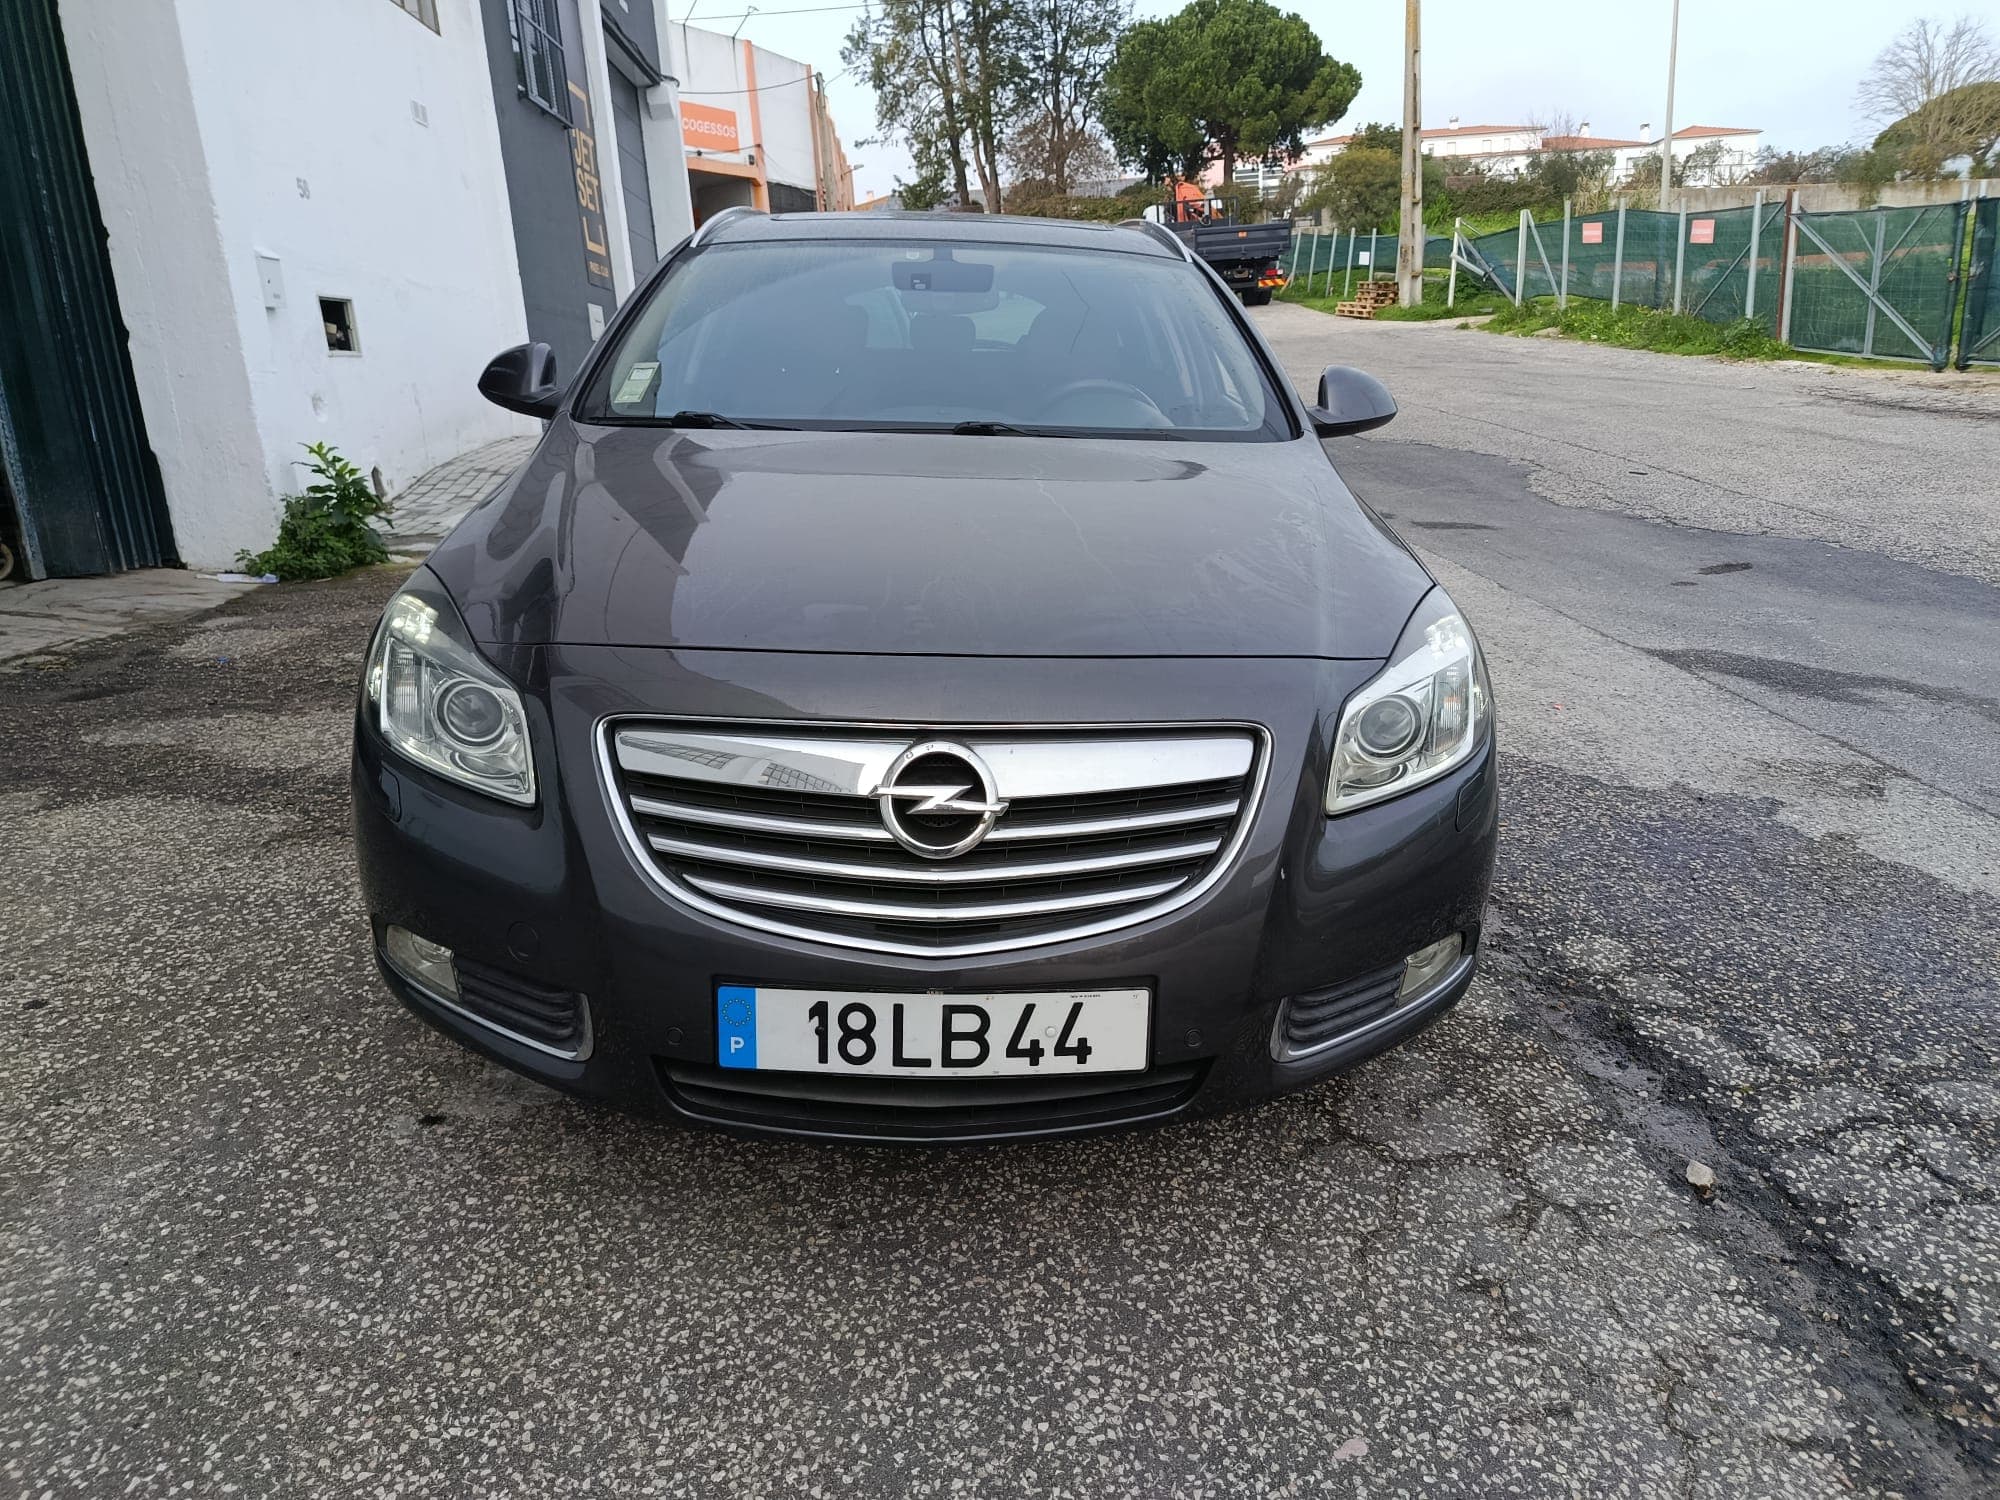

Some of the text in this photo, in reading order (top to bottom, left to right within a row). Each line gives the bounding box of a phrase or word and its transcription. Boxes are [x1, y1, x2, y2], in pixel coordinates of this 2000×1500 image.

[571, 128, 595, 176] JET
[576, 166, 600, 214] SET
[730, 1036, 745, 1054] P
